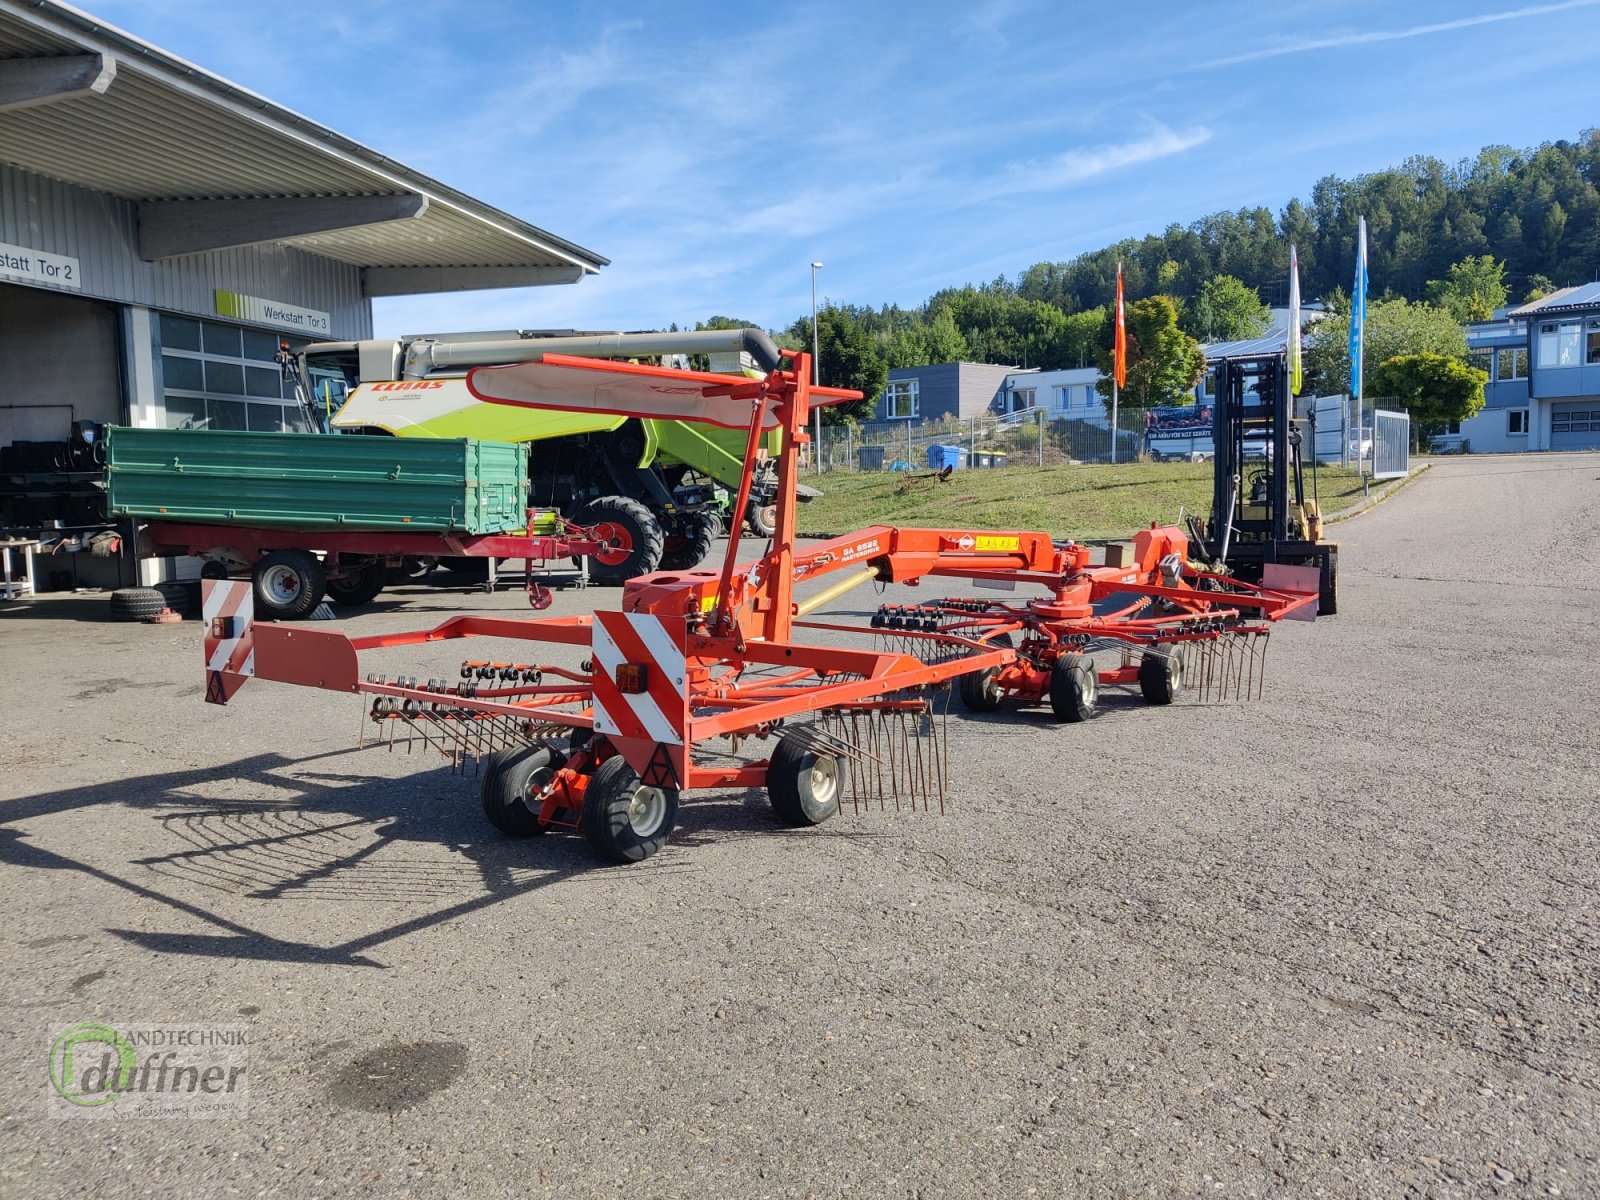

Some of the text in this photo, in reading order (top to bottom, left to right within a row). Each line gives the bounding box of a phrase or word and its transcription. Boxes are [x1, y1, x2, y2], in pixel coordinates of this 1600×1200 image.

[37, 259, 61, 277] Tor
[64, 265, 72, 280] 2
[263, 305, 327, 329] Werkstatt Tor 3
[371, 380, 446, 392] CLAAS
[843, 547, 855, 556] GA
